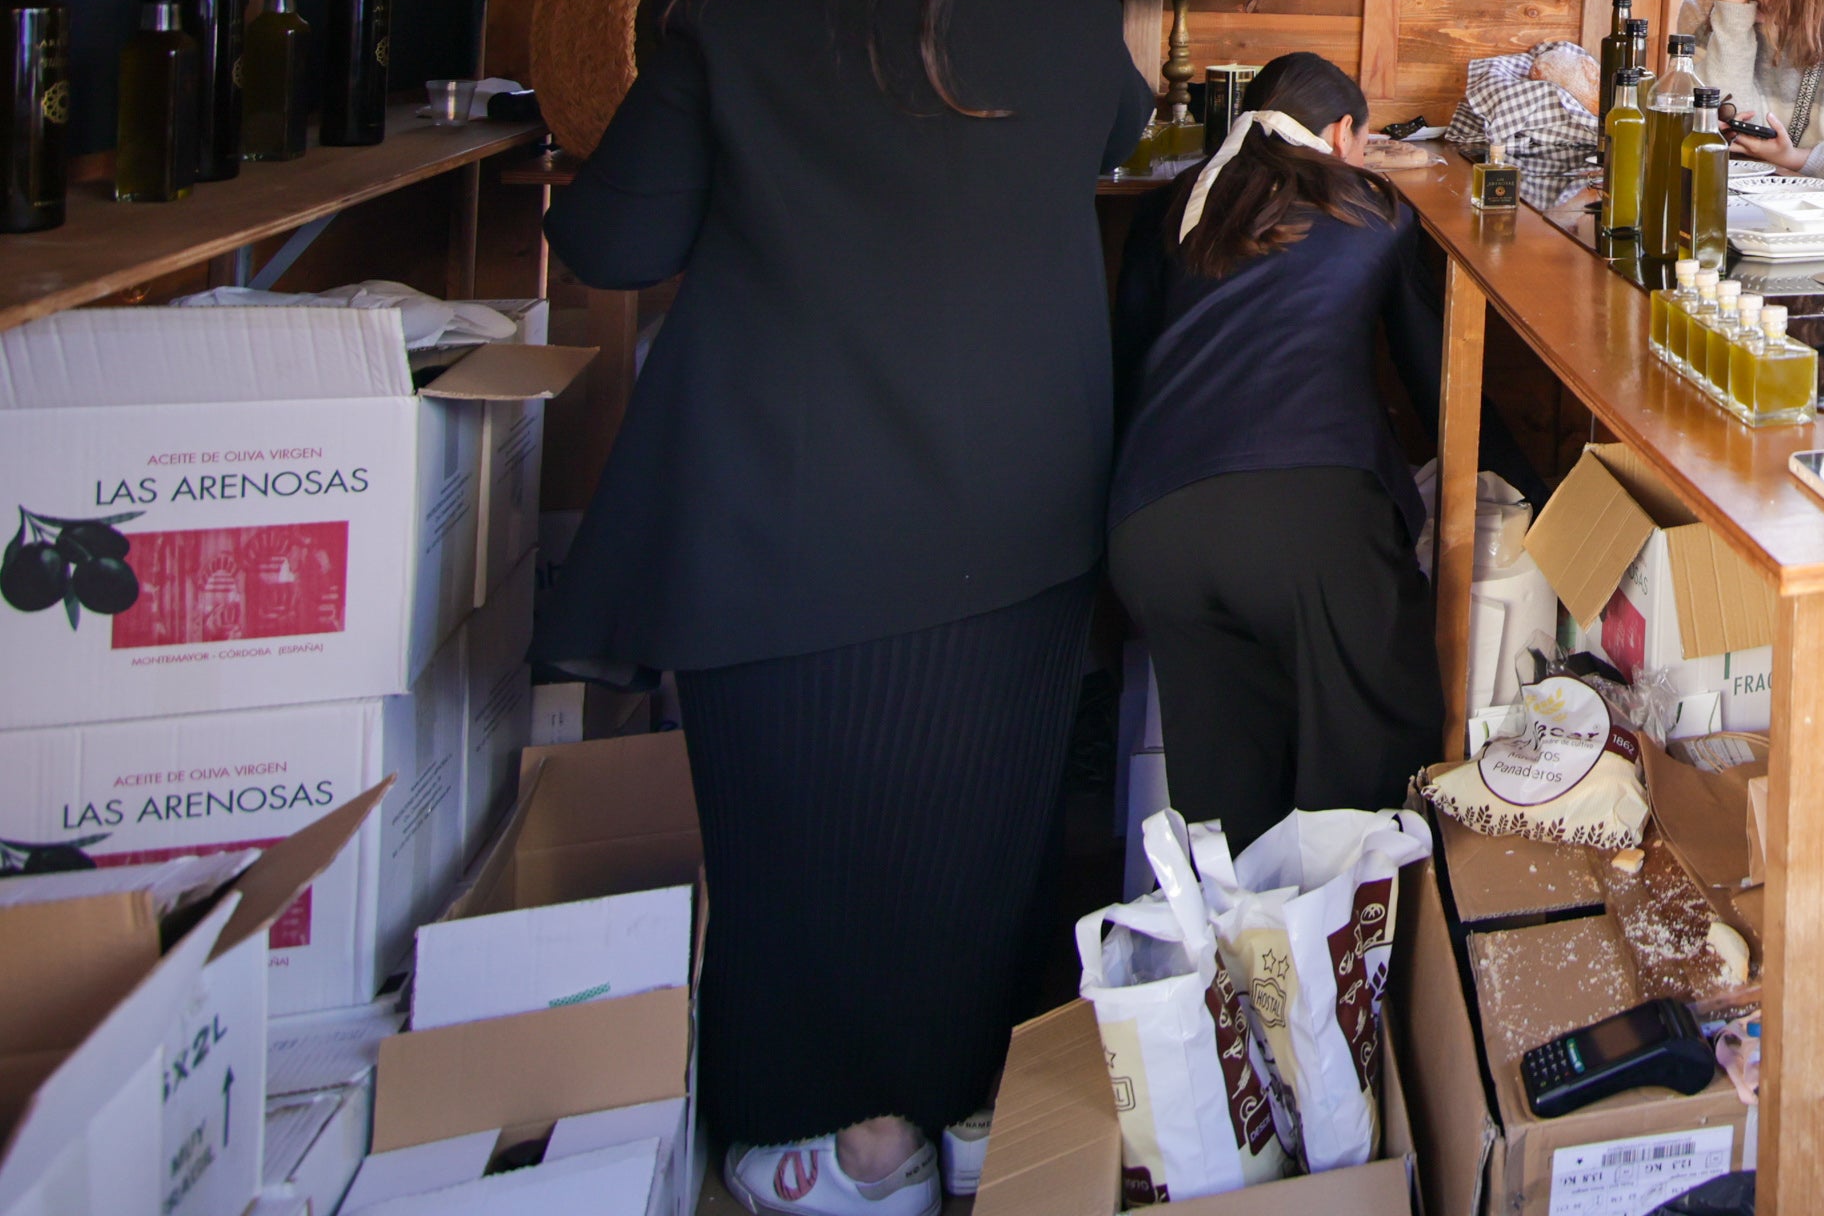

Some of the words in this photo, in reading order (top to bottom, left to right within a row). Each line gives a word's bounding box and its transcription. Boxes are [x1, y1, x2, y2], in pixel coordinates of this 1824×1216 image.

[147, 452, 197, 466] ACEITE
[201, 452, 220, 464] DE
[224, 450, 265, 462] OLIVA
[269, 447, 323, 461] VIRGEN
[95, 477, 158, 505] LAS
[170, 468, 369, 502] ARENOSAS
[131, 651, 210, 666] MONTEMAYOR
[218, 645, 272, 659] CÓRDOBA
[1611, 733, 1636, 755] 1862
[113, 774, 162, 788] ACEITE
[167, 770, 186, 783] DE
[190, 767, 230, 780] OLIVA
[234, 761, 288, 777] VIRGEN
[1492, 761, 1563, 783] Panaderos
[63, 799, 124, 830] LAS
[136, 780, 334, 823] ARENOSAS
[1255, 989, 1281, 1017] HOSTAL
